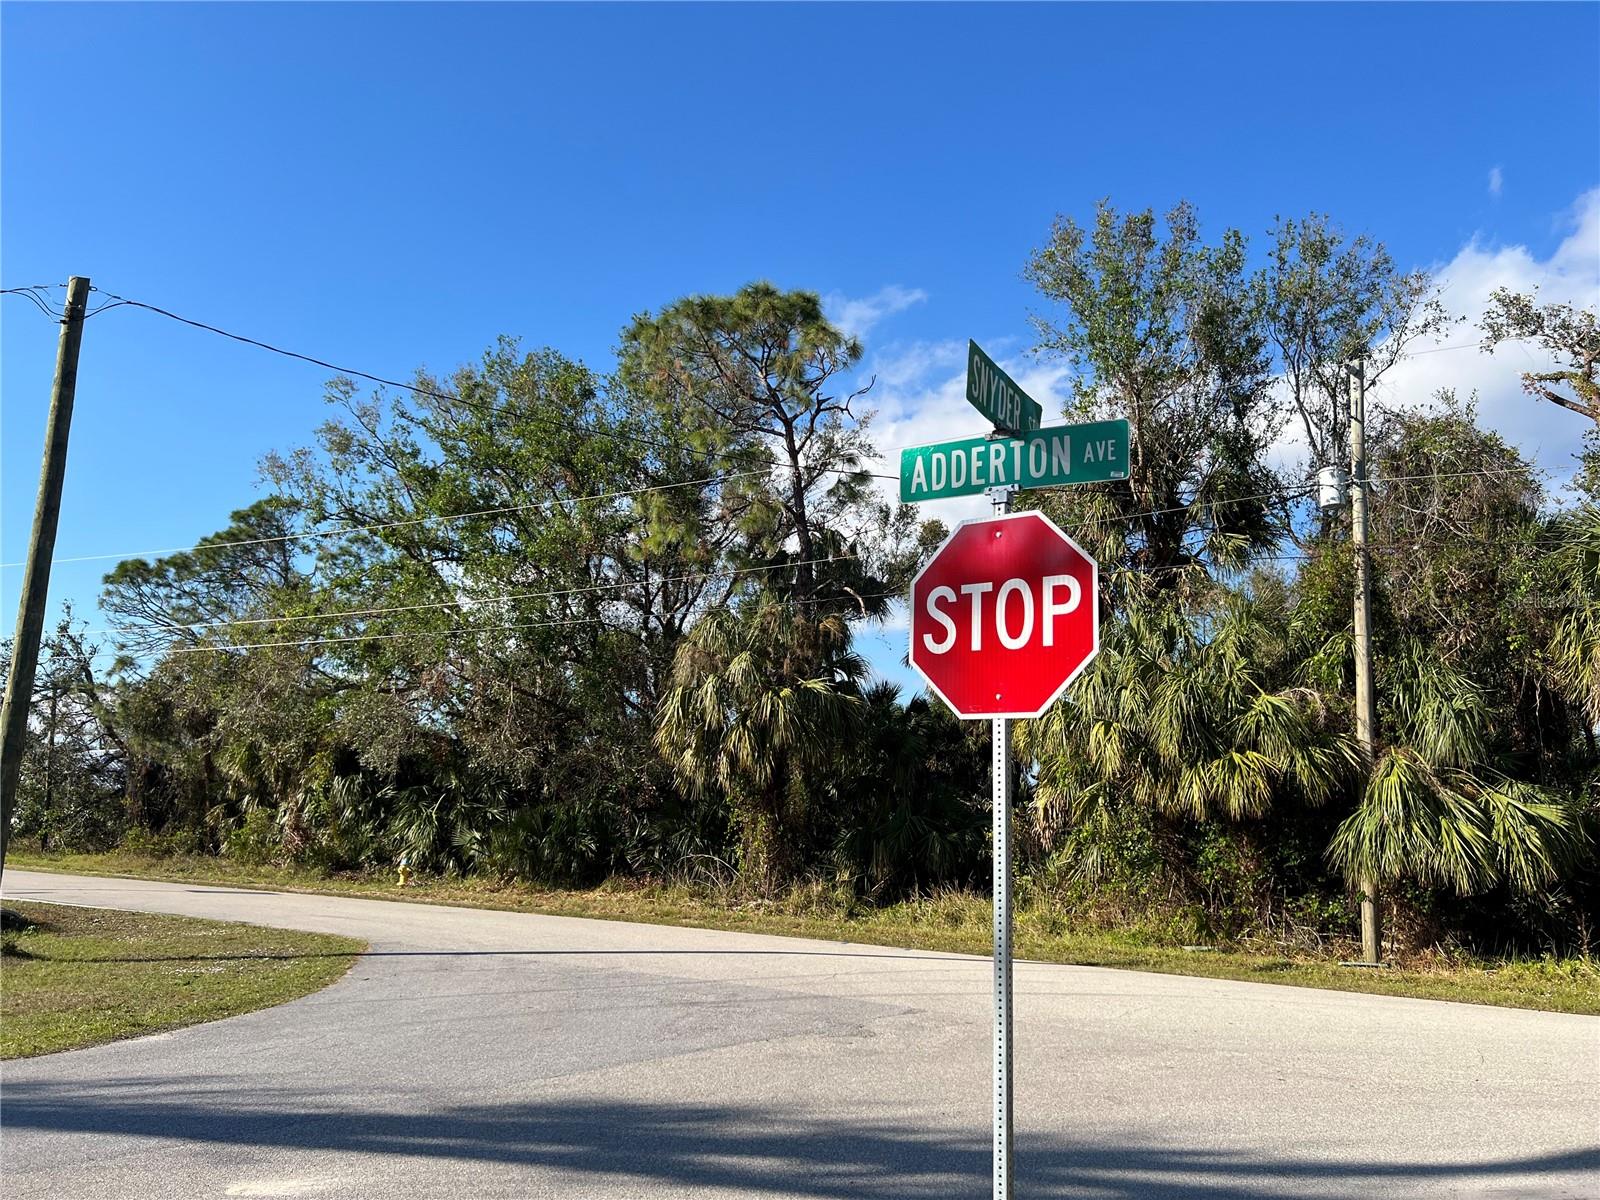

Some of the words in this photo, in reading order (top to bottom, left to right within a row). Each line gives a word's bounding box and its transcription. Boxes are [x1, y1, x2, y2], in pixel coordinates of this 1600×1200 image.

[971, 354, 1021, 430] SNYDER
[910, 435, 1071, 494] ADDERTON
[1083, 439, 1117, 464] AVE
[923, 574, 1082, 655] STOP
